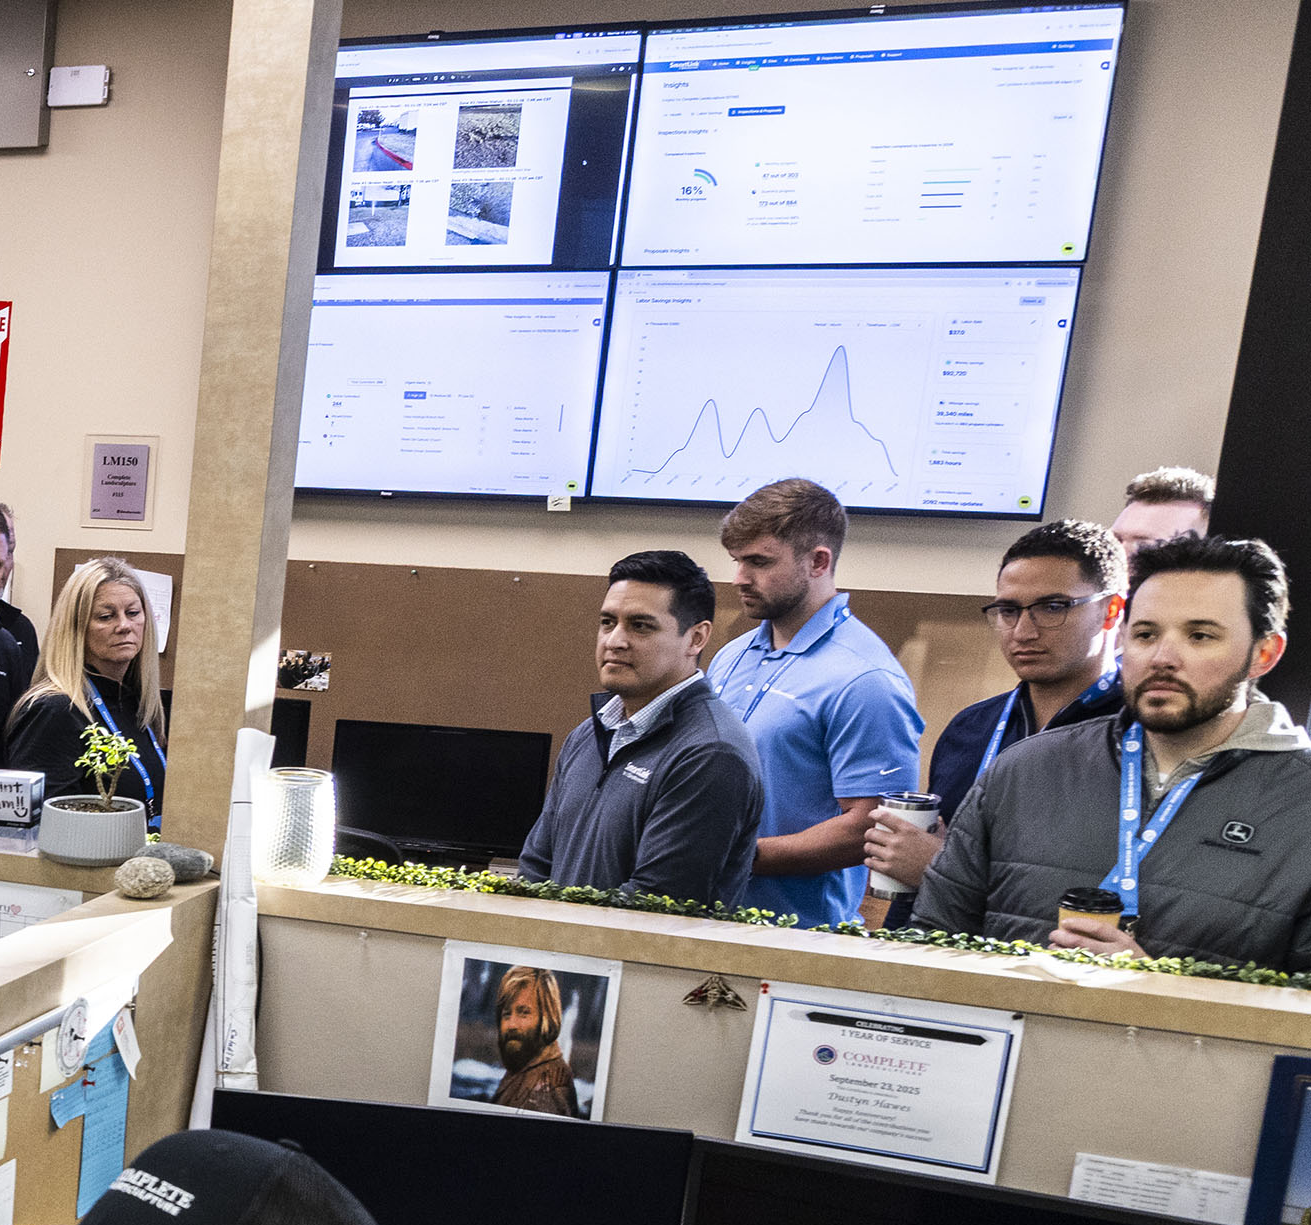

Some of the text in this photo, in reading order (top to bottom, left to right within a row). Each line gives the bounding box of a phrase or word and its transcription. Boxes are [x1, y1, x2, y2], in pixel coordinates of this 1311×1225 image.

[663, 81, 690, 89] Insights
[681, 186, 703, 196] 16%
[102, 455, 139, 467] LM150
[855, 1020, 905, 1033] CELEBRATING
[848, 1030, 874, 1041] YEAR
[876, 1035, 889, 1043] OF
[890, 1036, 932, 1049] SERVICE
[842, 1050, 929, 1072] COMPLETE
[829, 1074, 921, 1095] September 23, 2025
[828, 1091, 912, 1112] Dustyn Hawes
[799, 1108, 818, 1117] Thank
[872, 1119, 916, 1132] contributions
[832, 1106, 897, 1121] Happy Anniversary!
[793, 1115, 810, 1123] have
[810, 1117, 829, 1125] made
[829, 1119, 856, 1130] towards
